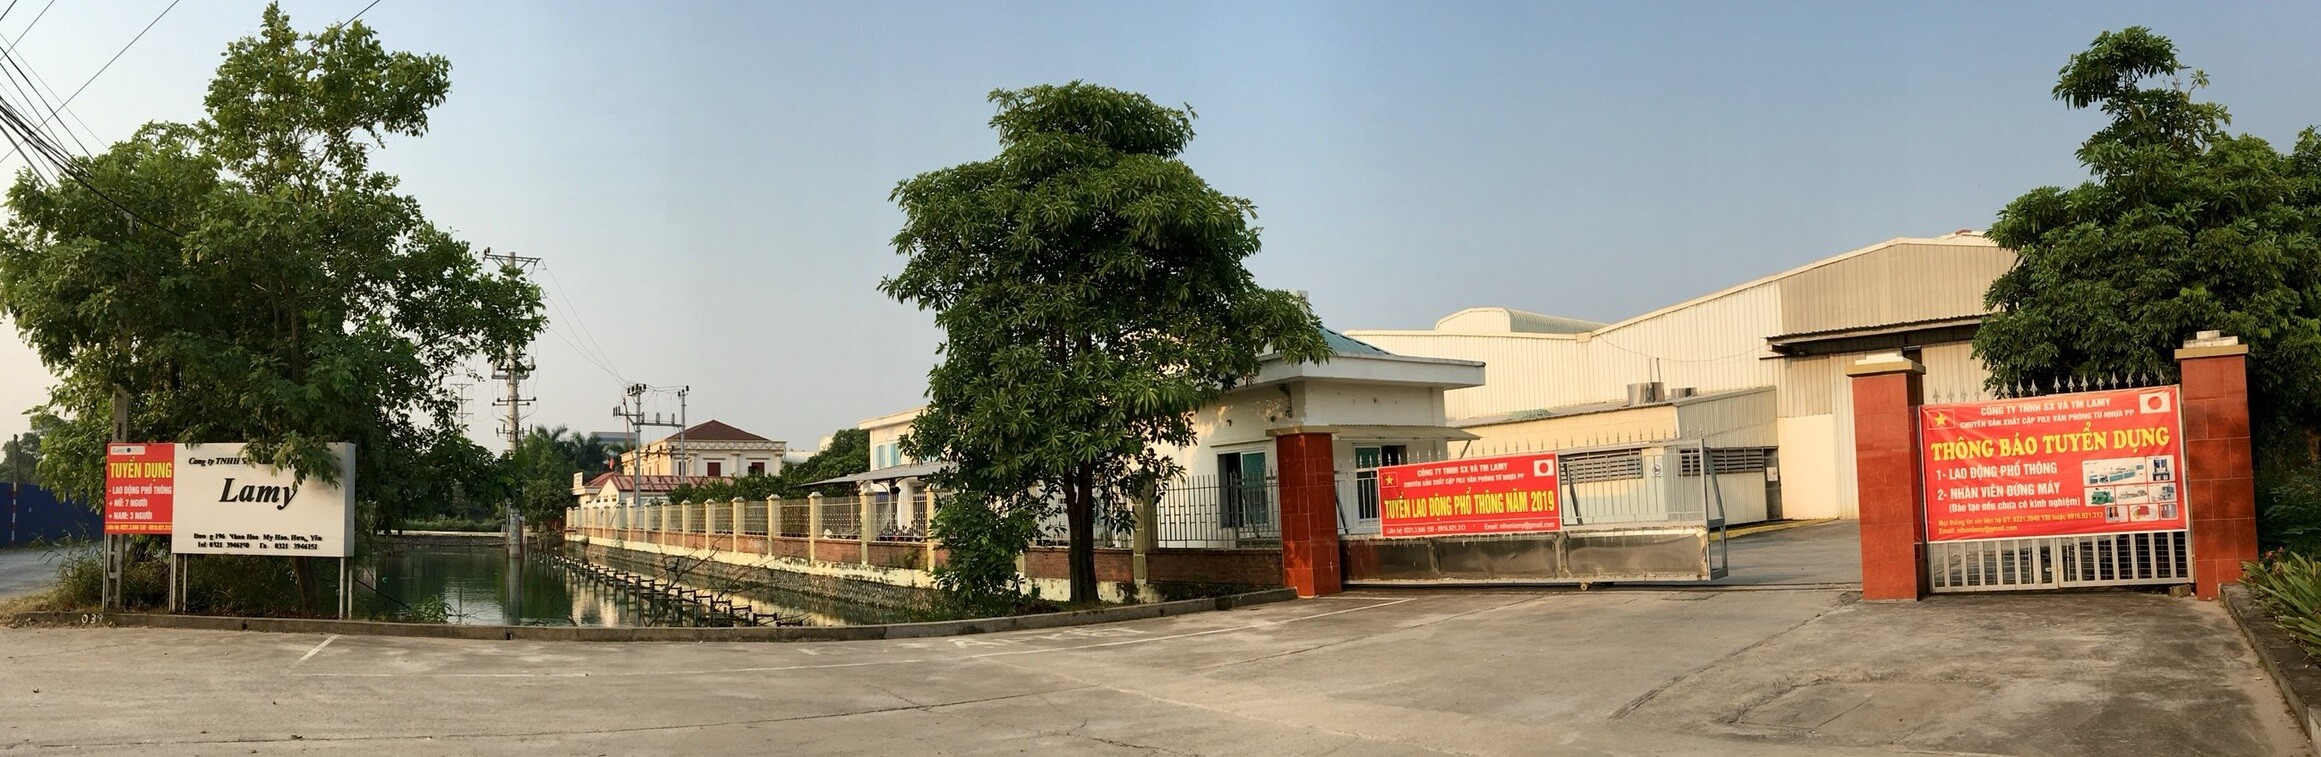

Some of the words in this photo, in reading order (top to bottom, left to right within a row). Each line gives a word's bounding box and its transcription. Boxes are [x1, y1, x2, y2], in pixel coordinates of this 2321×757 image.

[1980, 404, 2004, 416] CÔNG
[2006, 404, 2016, 414] TY
[2018, 403, 2041, 413] TNHH
[2044, 402, 2055, 412] SX
[2071, 400, 2084, 410] TM
[2086, 398, 2111, 408] LAMY
[1960, 419, 1986, 430] CHUYÊN
[2003, 415, 2020, 426] XUẤT
[2038, 415, 2052, 424] FILE
[2052, 412, 2067, 423] VĂN
[2068, 411, 2092, 422] PHÒNG
[2105, 409, 2124, 420] NHỰA
[2125, 409, 2135, 417] PP
[1930, 436, 1995, 461] THÔNG
[1998, 432, 2038, 457] BÁO
[2042, 421, 2108, 454] TUYỂN
[2112, 426, 2170, 454] DỤNG
[110, 456, 142, 478] TUYỂN
[144, 462, 172, 482] DỤNG
[207, 458, 214, 466] ty
[1417, 467, 1434, 477] CÔNG
[1434, 468, 1442, 476] TY
[1460, 466, 1468, 474] SX
[1470, 464, 1478, 473] VÀ
[1490, 462, 1508, 472] LAMY
[1936, 469, 1946, 480] 1-
[1948, 467, 1968, 480] LAO
[1970, 464, 1998, 481] ĐỘNG
[2000, 460, 2021, 478] PHỔ
[2023, 460, 2058, 476] THÔNG
[112, 486, 123, 494] LAO
[124, 484, 140, 496] ĐỘNG
[140, 483, 152, 494] PHỔ
[154, 485, 172, 494] THÔNG
[218, 478, 298, 510] Lamy
[1937, 489, 1948, 500] 2-
[1950, 486, 1978, 500] NHÂN
[1981, 484, 2004, 498] VIÊN
[2006, 482, 2036, 497] ĐỨNG
[2037, 480, 2060, 495] MÁY
[130, 498, 148, 507] NGƯỜI
[1384, 491, 1410, 520] TUYỂN
[1412, 498, 1427, 518] LAO
[1429, 493, 1452, 522] ĐỘNG
[1454, 486, 1472, 516] PHỔ
[1474, 490, 1504, 516] THÔNG
[1506, 488, 1528, 513] NĂM
[1530, 490, 1555, 512] 2019
[1968, 502, 1980, 514] tạo
[2018, 498, 2028, 509] có
[2030, 498, 2046, 508] kinh
[2048, 496, 2080, 508] nghiệm)
[114, 512, 129, 520] NAM:
[130, 512, 134, 520] 3
[135, 510, 152, 520] NGƯỜI
